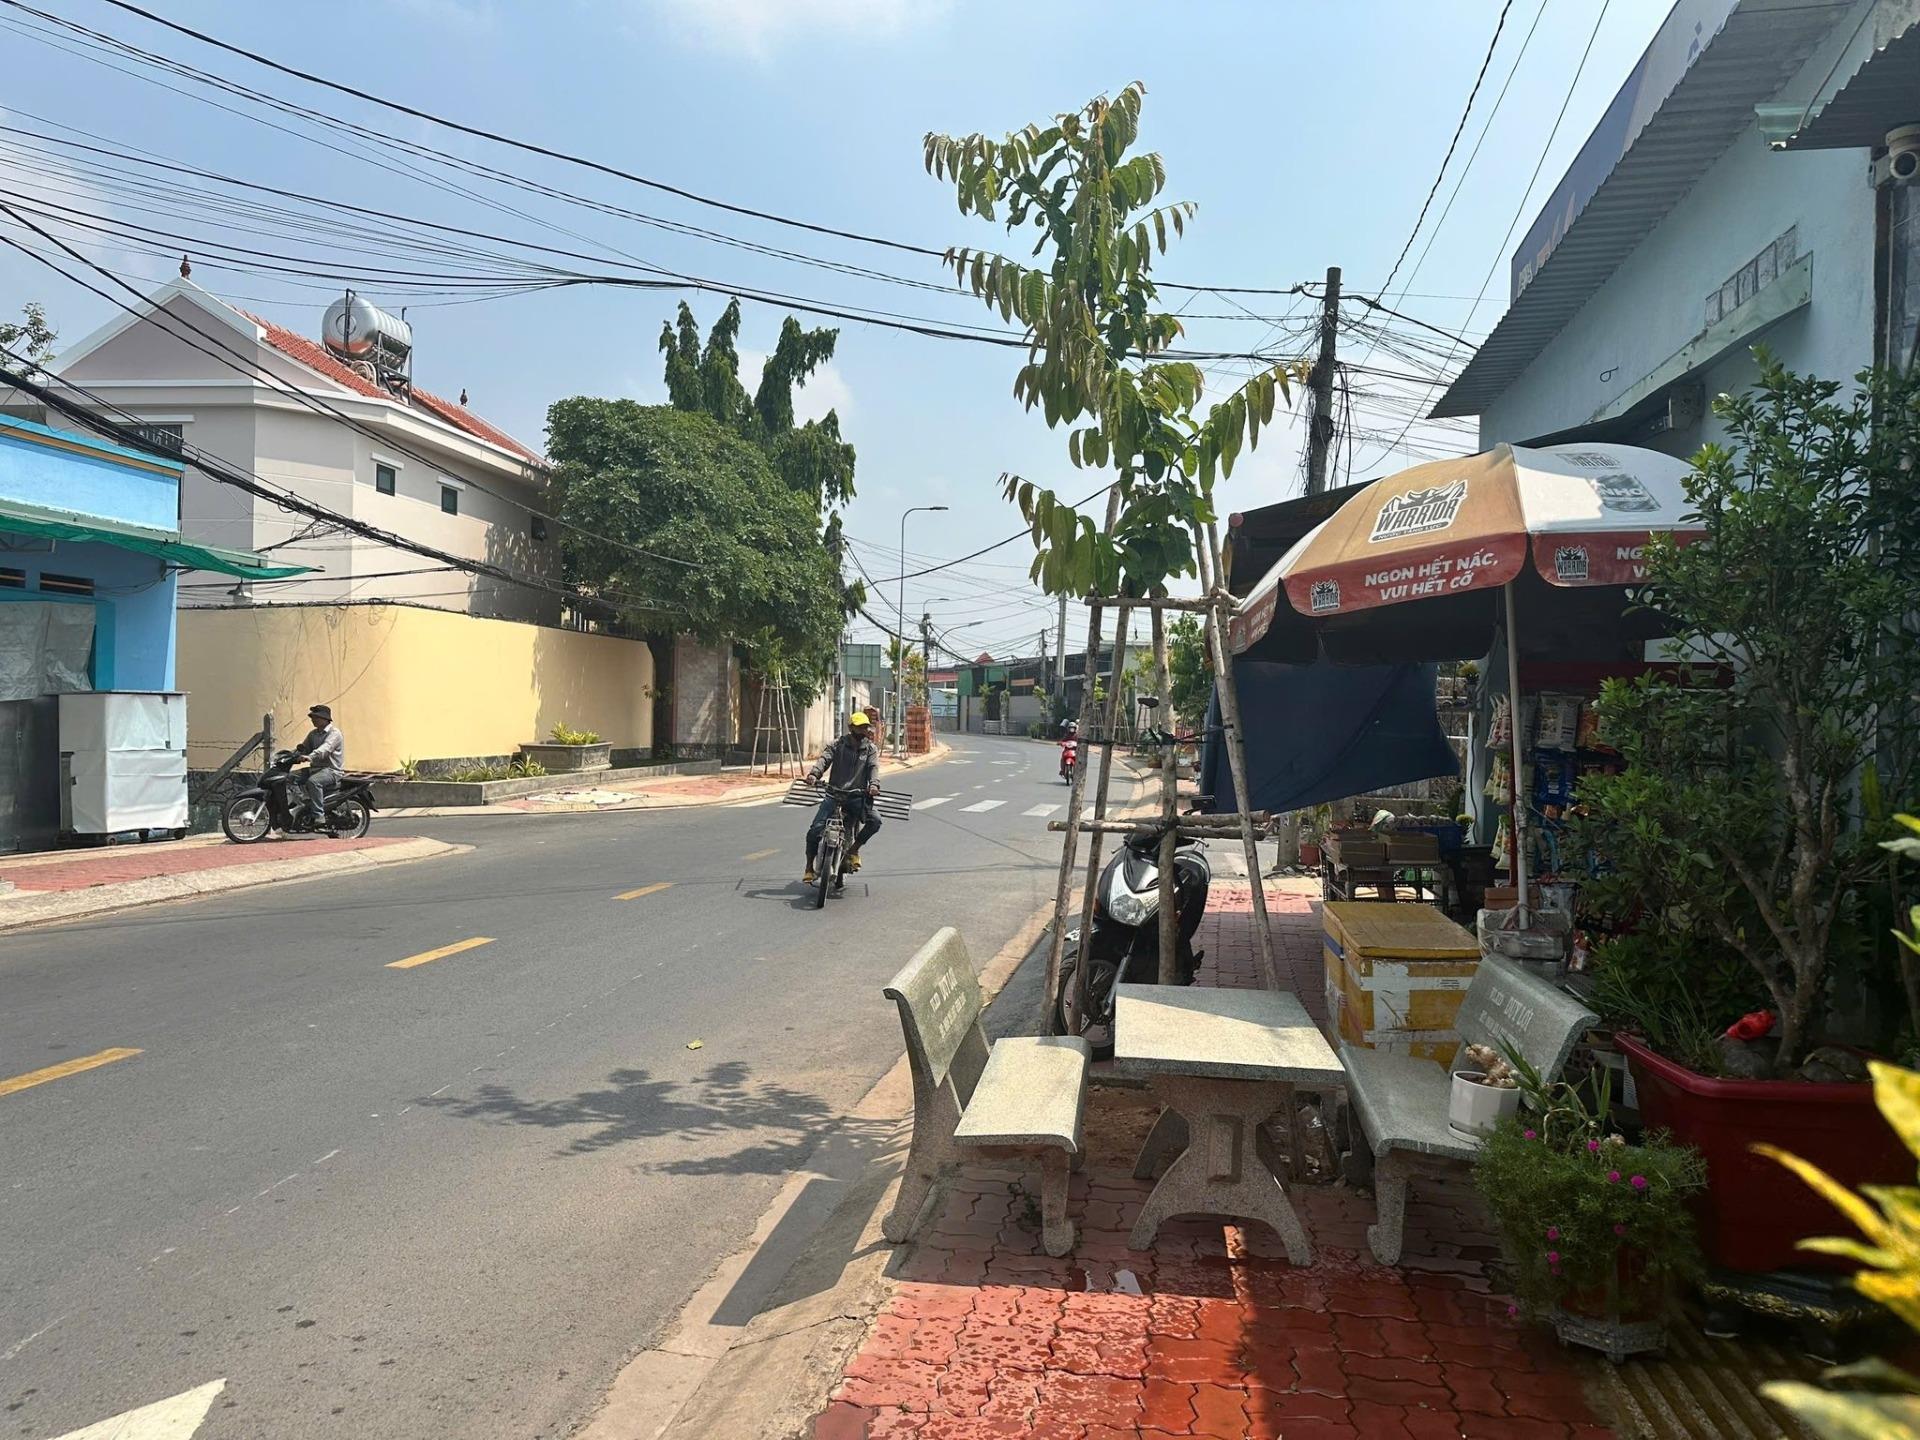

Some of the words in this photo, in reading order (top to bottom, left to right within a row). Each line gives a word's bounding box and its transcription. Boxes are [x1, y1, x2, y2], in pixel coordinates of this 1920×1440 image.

[1376, 498, 1460, 533] WARRIOR
[1364, 566, 1415, 587] NGON
[1418, 555, 1453, 577] HẾT
[1456, 548, 1499, 571] NẤC,
[1379, 584, 1409, 601] VUI
[1411, 575, 1446, 596] HẾT
